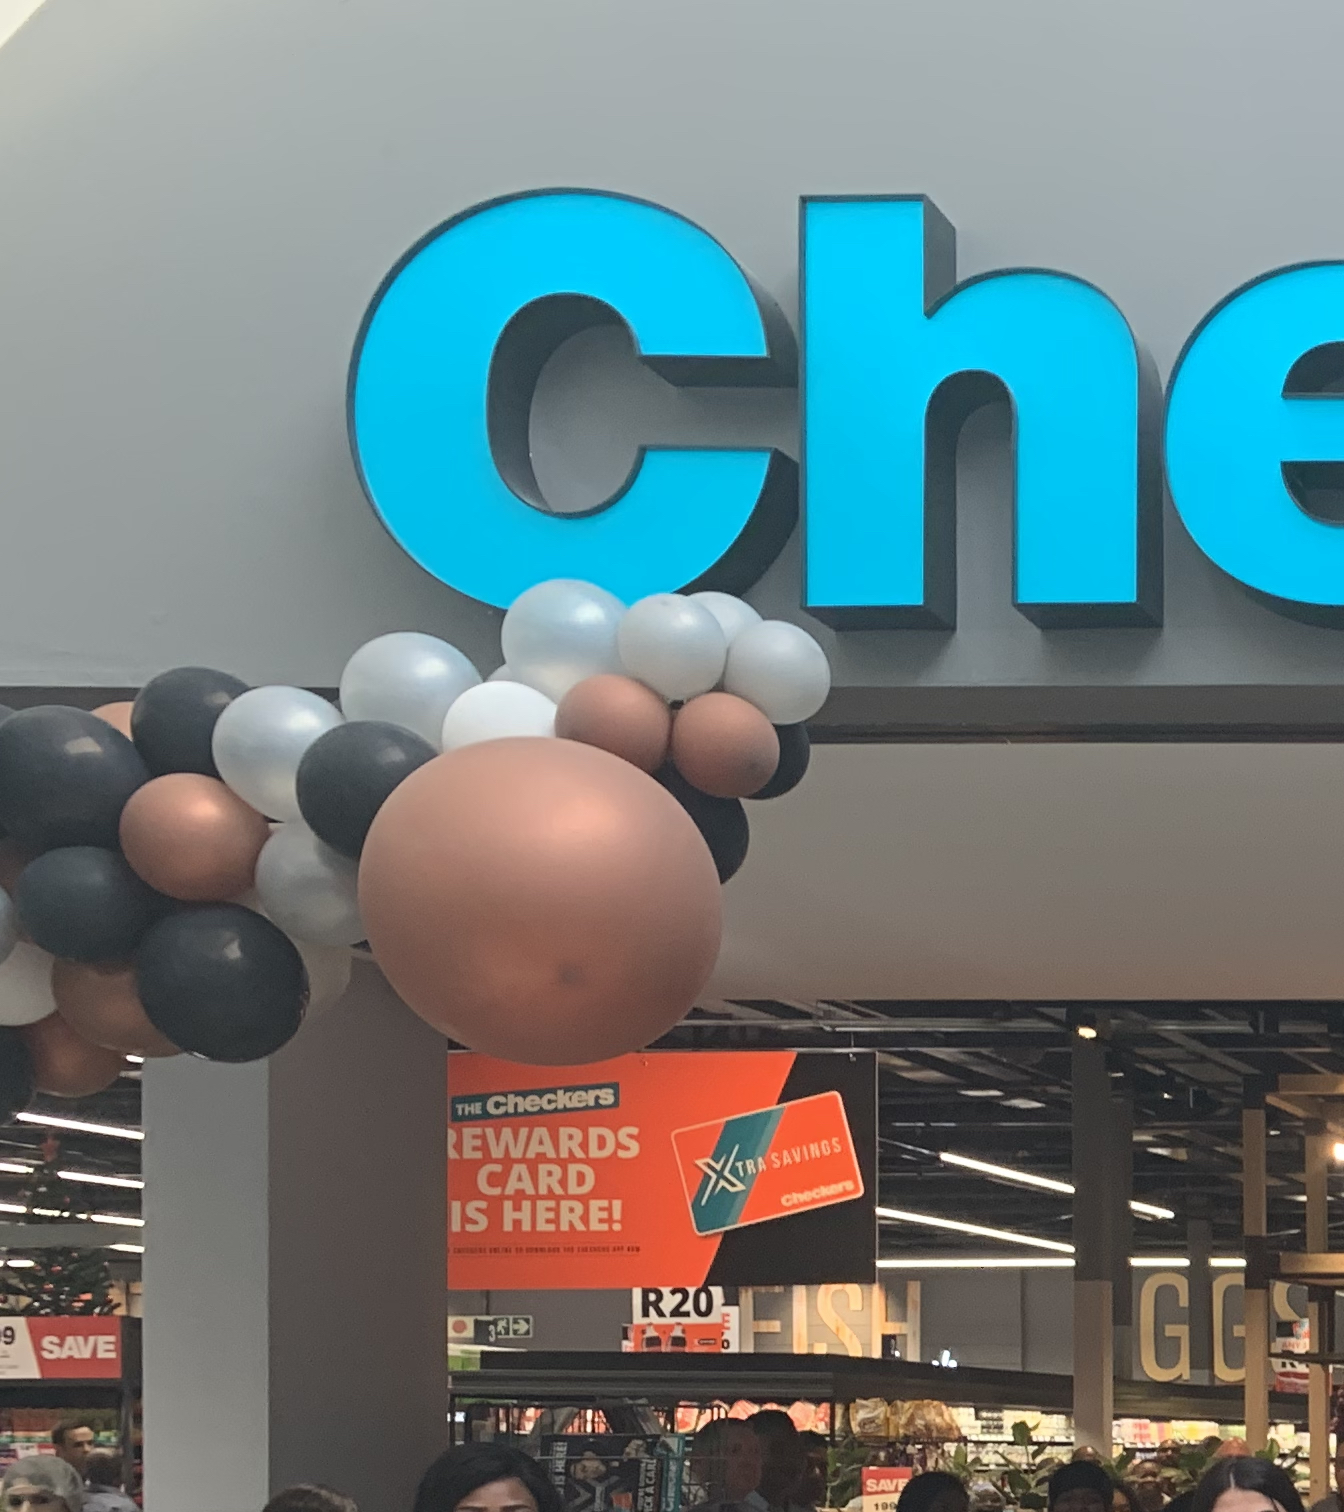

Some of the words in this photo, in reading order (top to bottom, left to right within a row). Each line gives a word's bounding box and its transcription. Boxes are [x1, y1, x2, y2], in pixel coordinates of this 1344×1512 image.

[455, 1101, 482, 1116] THE
[486, 1085, 615, 1116] Checkers
[771, 1137, 842, 1169] SAVINGS
[476, 1163, 596, 1196] CARD
[780, 1180, 855, 1207] Checkers
[451, 1200, 489, 1233] IS
[503, 1199, 623, 1232] HERE!
[641, 1287, 714, 1318] R20
[41, 1335, 117, 1360] SAVE
[866, 1478, 910, 1492] SAVE
